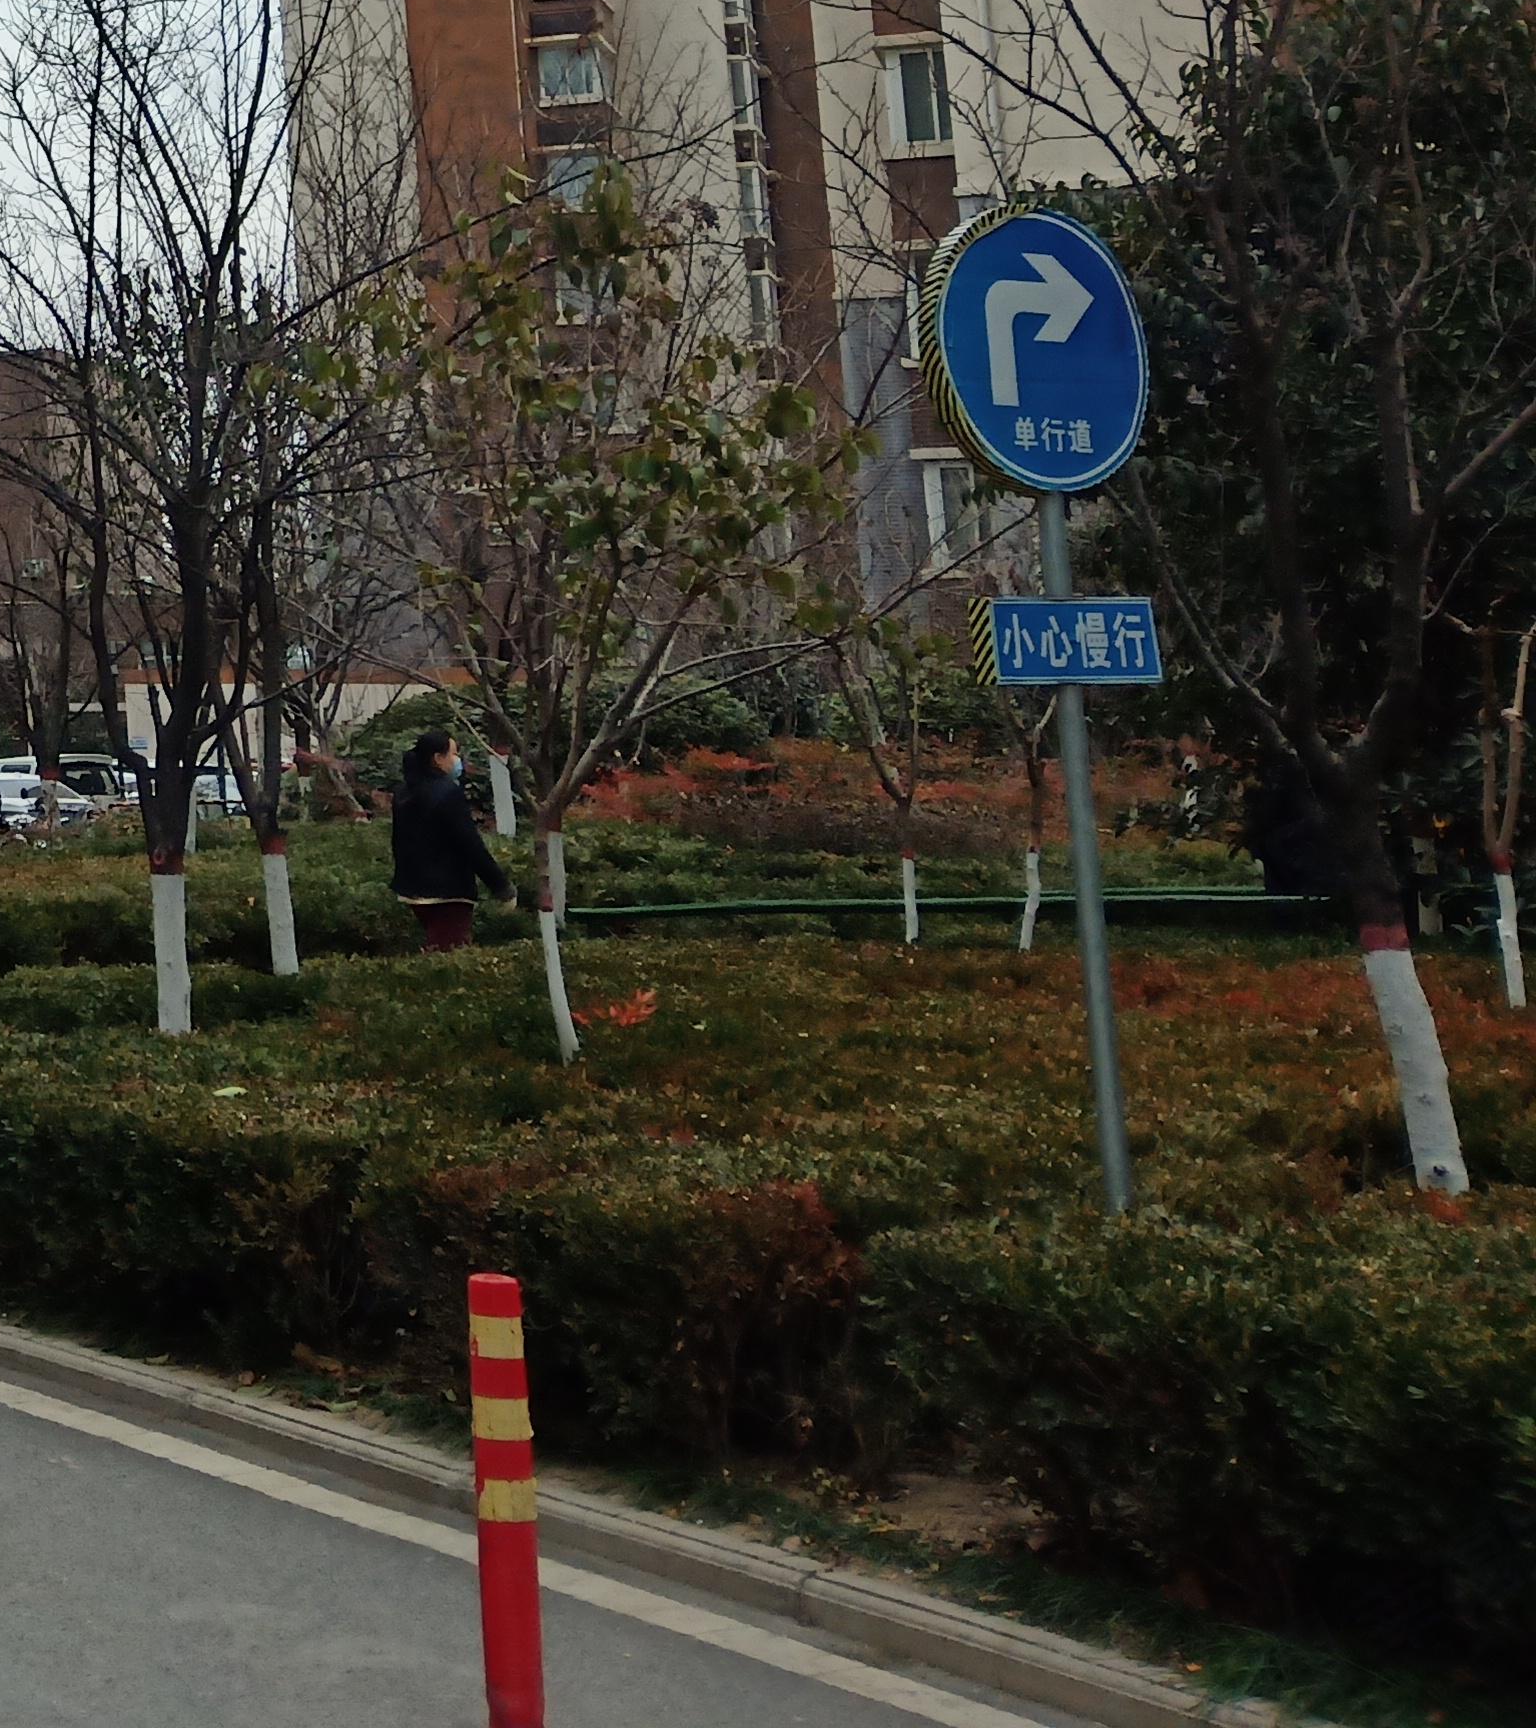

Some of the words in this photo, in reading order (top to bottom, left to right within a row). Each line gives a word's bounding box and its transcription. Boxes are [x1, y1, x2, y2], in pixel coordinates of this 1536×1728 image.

[1014, 417, 1094, 454] 单行道
[1003, 611, 1146, 668] 小心慢行
